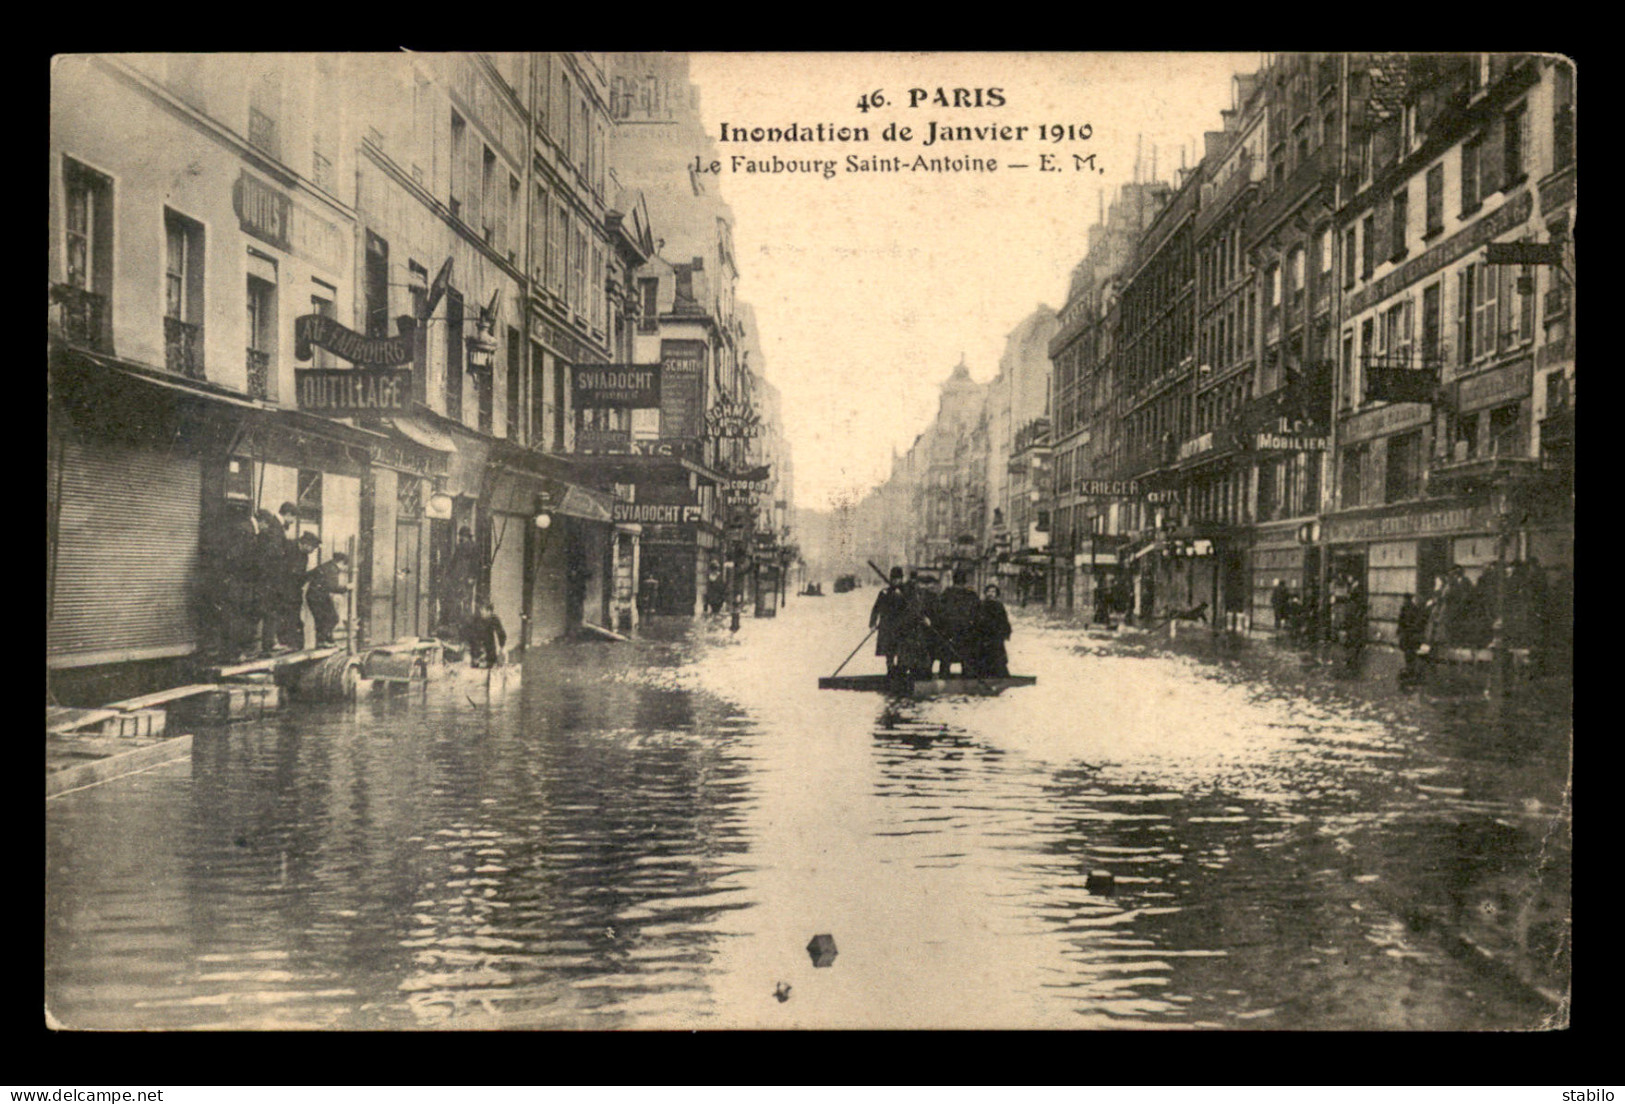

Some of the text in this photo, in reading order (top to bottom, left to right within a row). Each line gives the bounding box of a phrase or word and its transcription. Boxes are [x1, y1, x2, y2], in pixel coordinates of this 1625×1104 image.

[578, 371, 654, 390] SVIADOCHT
[302, 374, 402, 409] OUTILLAGE
[1080, 480, 1140, 496] KRIEGER
[613, 504, 681, 523] SVIADOCHT
